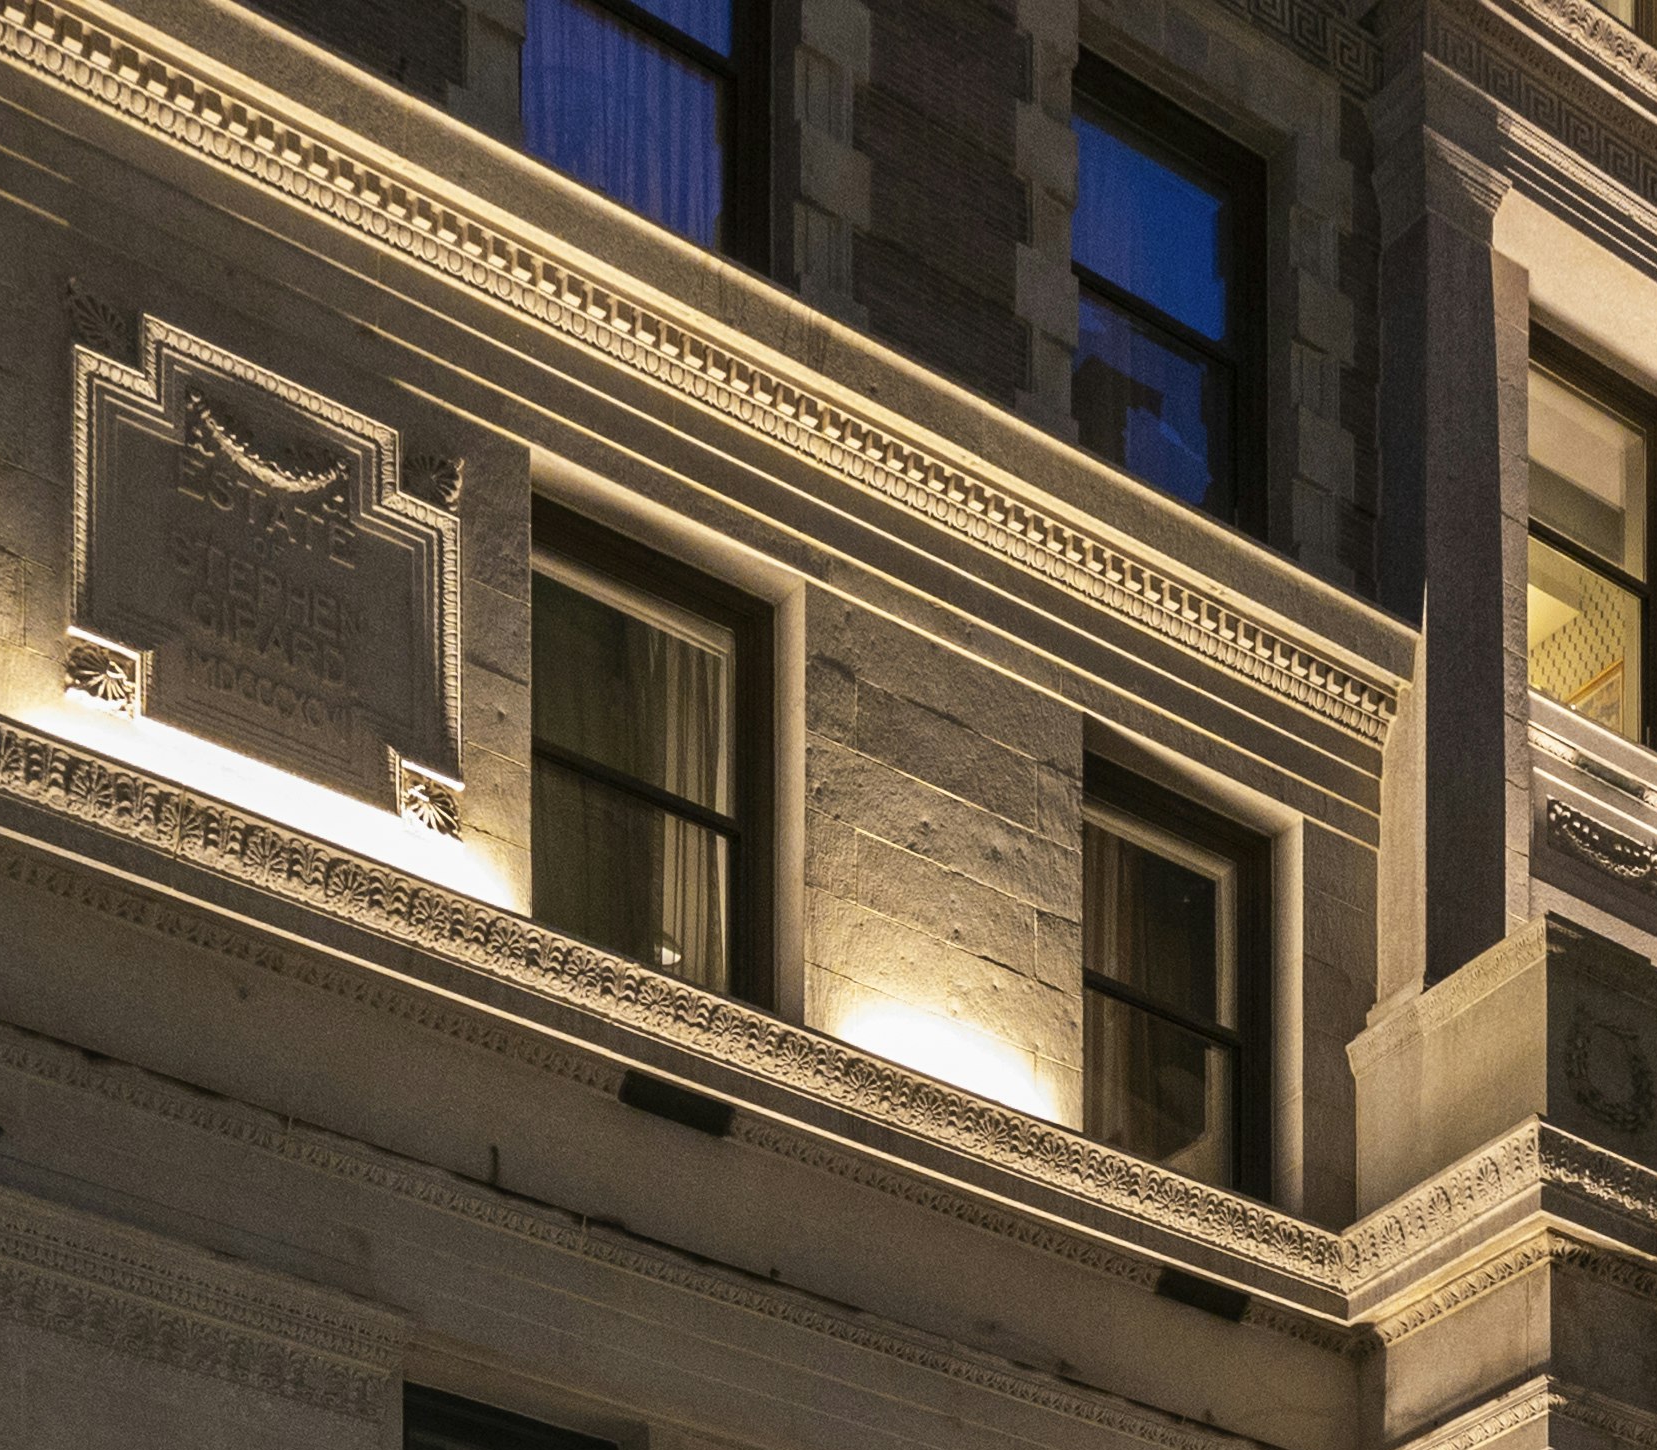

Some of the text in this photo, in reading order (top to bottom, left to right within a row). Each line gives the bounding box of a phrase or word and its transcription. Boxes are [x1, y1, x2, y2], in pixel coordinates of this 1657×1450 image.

[177, 452, 356, 570] ESTATE
[172, 531, 365, 640] STEPHEN
[192, 592, 348, 688] GIRARD
